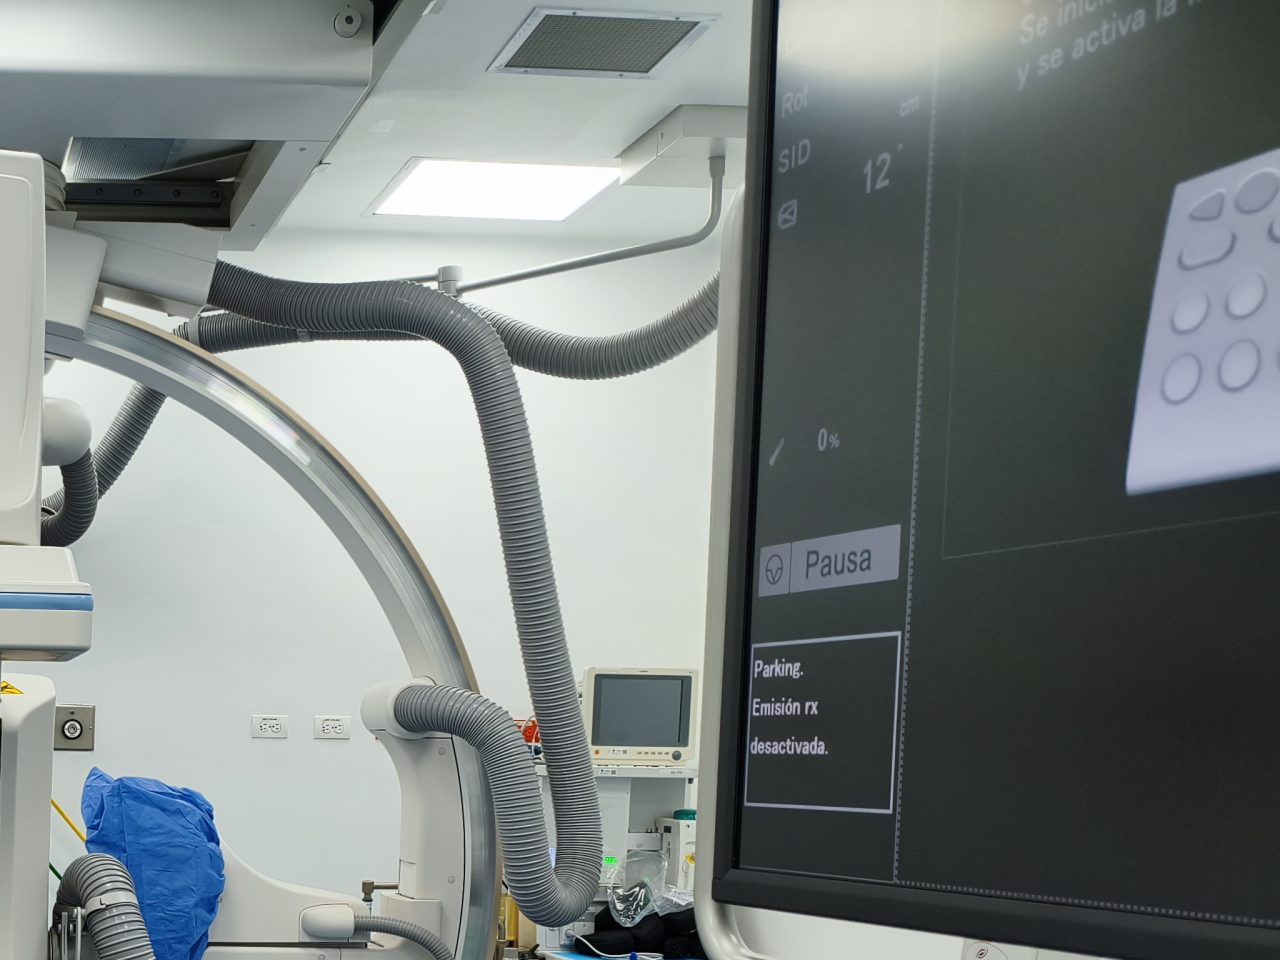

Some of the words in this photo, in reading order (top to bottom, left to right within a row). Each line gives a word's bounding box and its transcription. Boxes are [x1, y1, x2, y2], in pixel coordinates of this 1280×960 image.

[1020, 13, 1049, 45] Se
[1057, 0, 1113, 27] inic
[1017, 62, 1030, 91] y
[1037, 47, 1063, 75] se
[1072, 8, 1147, 60] activa
[1155, 0, 1178, 21] la
[782, 84, 810, 119] Rol
[778, 139, 811, 174] SID
[863, 151, 891, 194] 12
[805, 548, 872, 580] Pausa
[754, 658, 804, 679] Parking.
[752, 697, 801, 716] Emisión
[804, 701, 819, 715] rx
[750, 736, 829, 755] desactivada.
